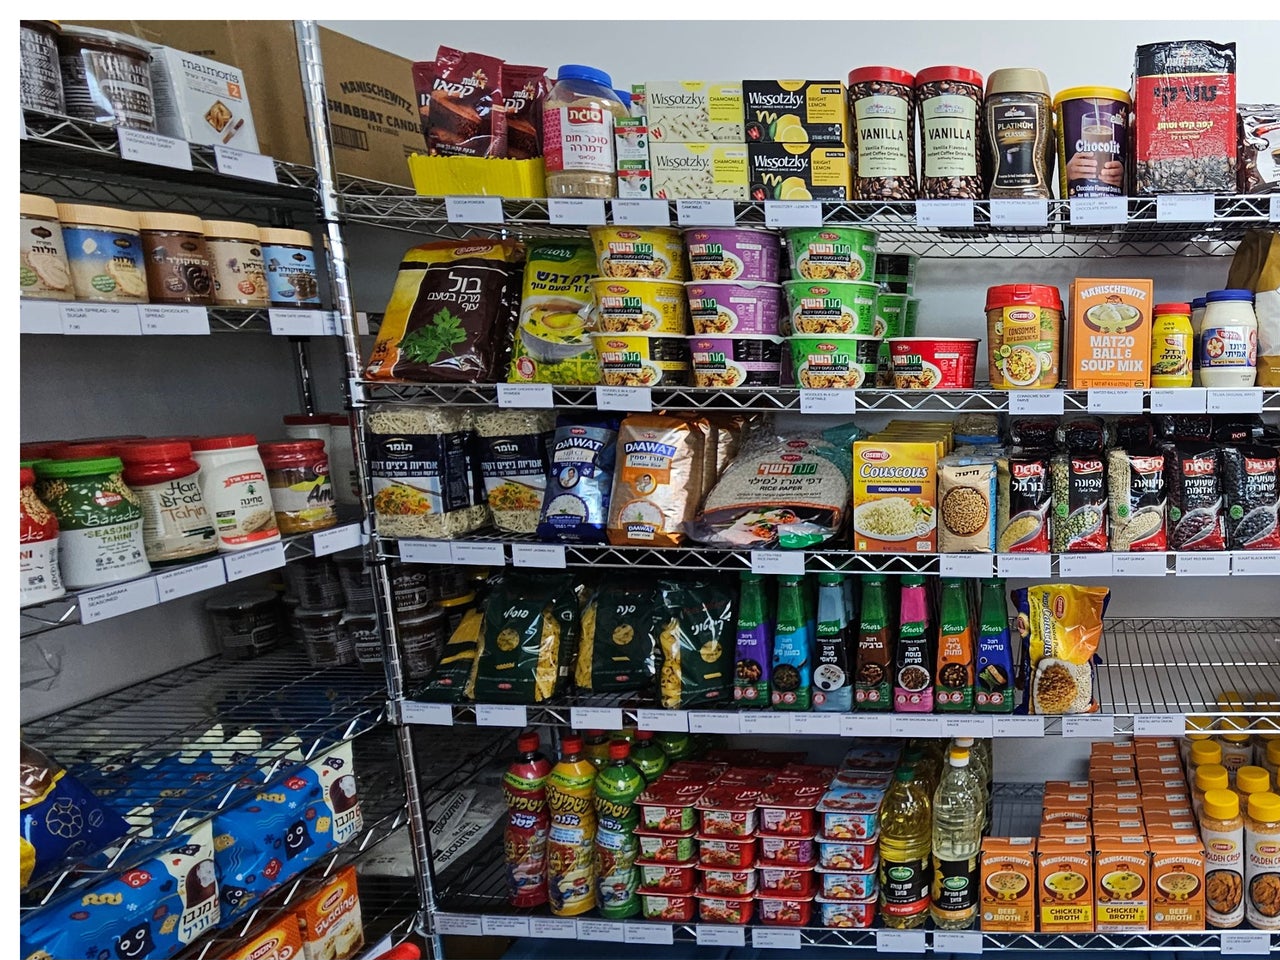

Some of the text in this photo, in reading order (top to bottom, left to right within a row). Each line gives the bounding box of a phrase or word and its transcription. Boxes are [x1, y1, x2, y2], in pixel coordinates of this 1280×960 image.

[433, 79, 474, 98] קקאו
[569, 108, 603, 124] סוגת
[860, 128, 904, 142] VANILLA
[928, 128, 971, 142] VANILLA
[1076, 140, 1120, 154] Chocolit
[447, 272, 482, 294] בול
[1081, 284, 1147, 301] MANISCHEWITZ
[462, 302, 479, 312] עוף
[1090, 335, 1135, 348] MATZO
[1092, 348, 1122, 360] BALL
[1081, 359, 1144, 373] SOUP MIX
[555, 437, 603, 451] DAAWAT
[625, 442, 677, 457] DAAWAT
[859, 462, 929, 479] Couscous
[1075, 478, 1102, 489] אפונה
[1049, 906, 1083, 917] CHICKEN
